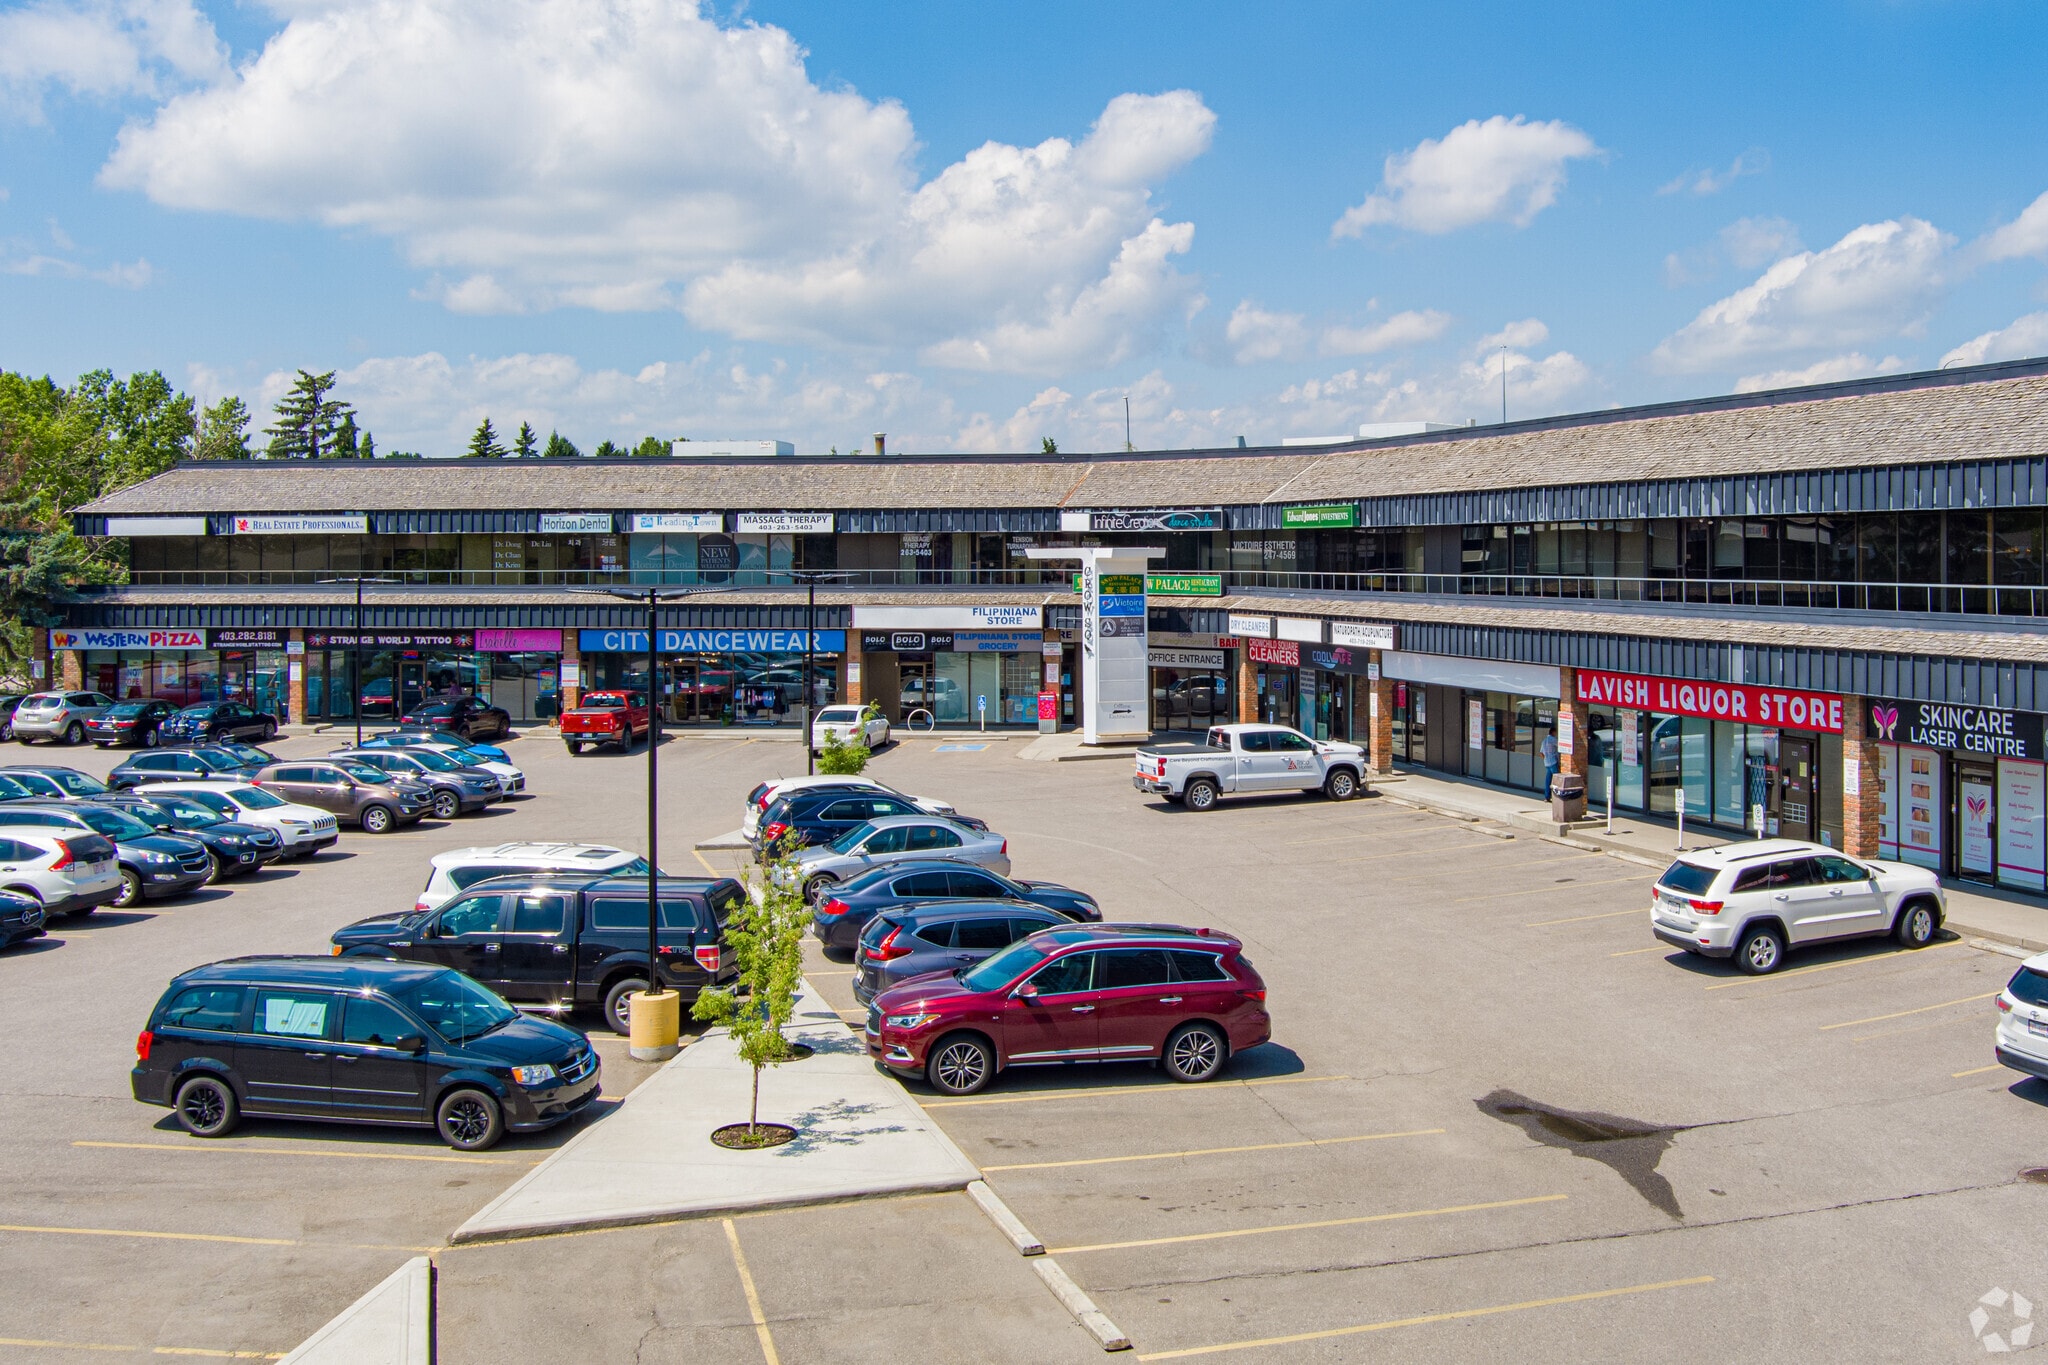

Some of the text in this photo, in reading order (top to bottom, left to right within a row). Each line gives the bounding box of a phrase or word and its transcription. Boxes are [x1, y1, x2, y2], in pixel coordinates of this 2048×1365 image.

[253, 521, 360, 529] REAL ESTATE PROFESSIONALS
[544, 518, 609, 529] Horizon Dental
[1234, 540, 1296, 550] VICTOIRE ESTHETIC
[701, 548, 731, 557] NEW
[1264, 550, 1296, 559] 247-4569
[1156, 579, 1190, 590] PALACE
[1115, 598, 1143, 606] Victoire
[973, 608, 1037, 616] FILIPINIANA
[1231, 620, 1269, 632] DRY CLEANERS
[85, 632, 148, 647] WESTERN
[219, 632, 276, 640] 403.282.8181
[378, 636, 410, 644] WORLD
[414, 636, 452, 644] TATTOO
[480, 631, 518, 648] Isabelle
[955, 633, 1042, 641] FILIPINIANA STORE
[978, 642, 1019, 650] GROCERY
[1249, 638, 1299, 651] CROWCHILD SQUARE
[1148, 653, 1222, 664] OFFICE ENTRANCE
[1249, 647, 1299, 666] CLEANERS
[1578, 674, 1842, 729] LAVISH LIQUOR STORE
[1919, 704, 2014, 735] SKINCARE
[1910, 726, 2026, 757] LASER CENTRE
